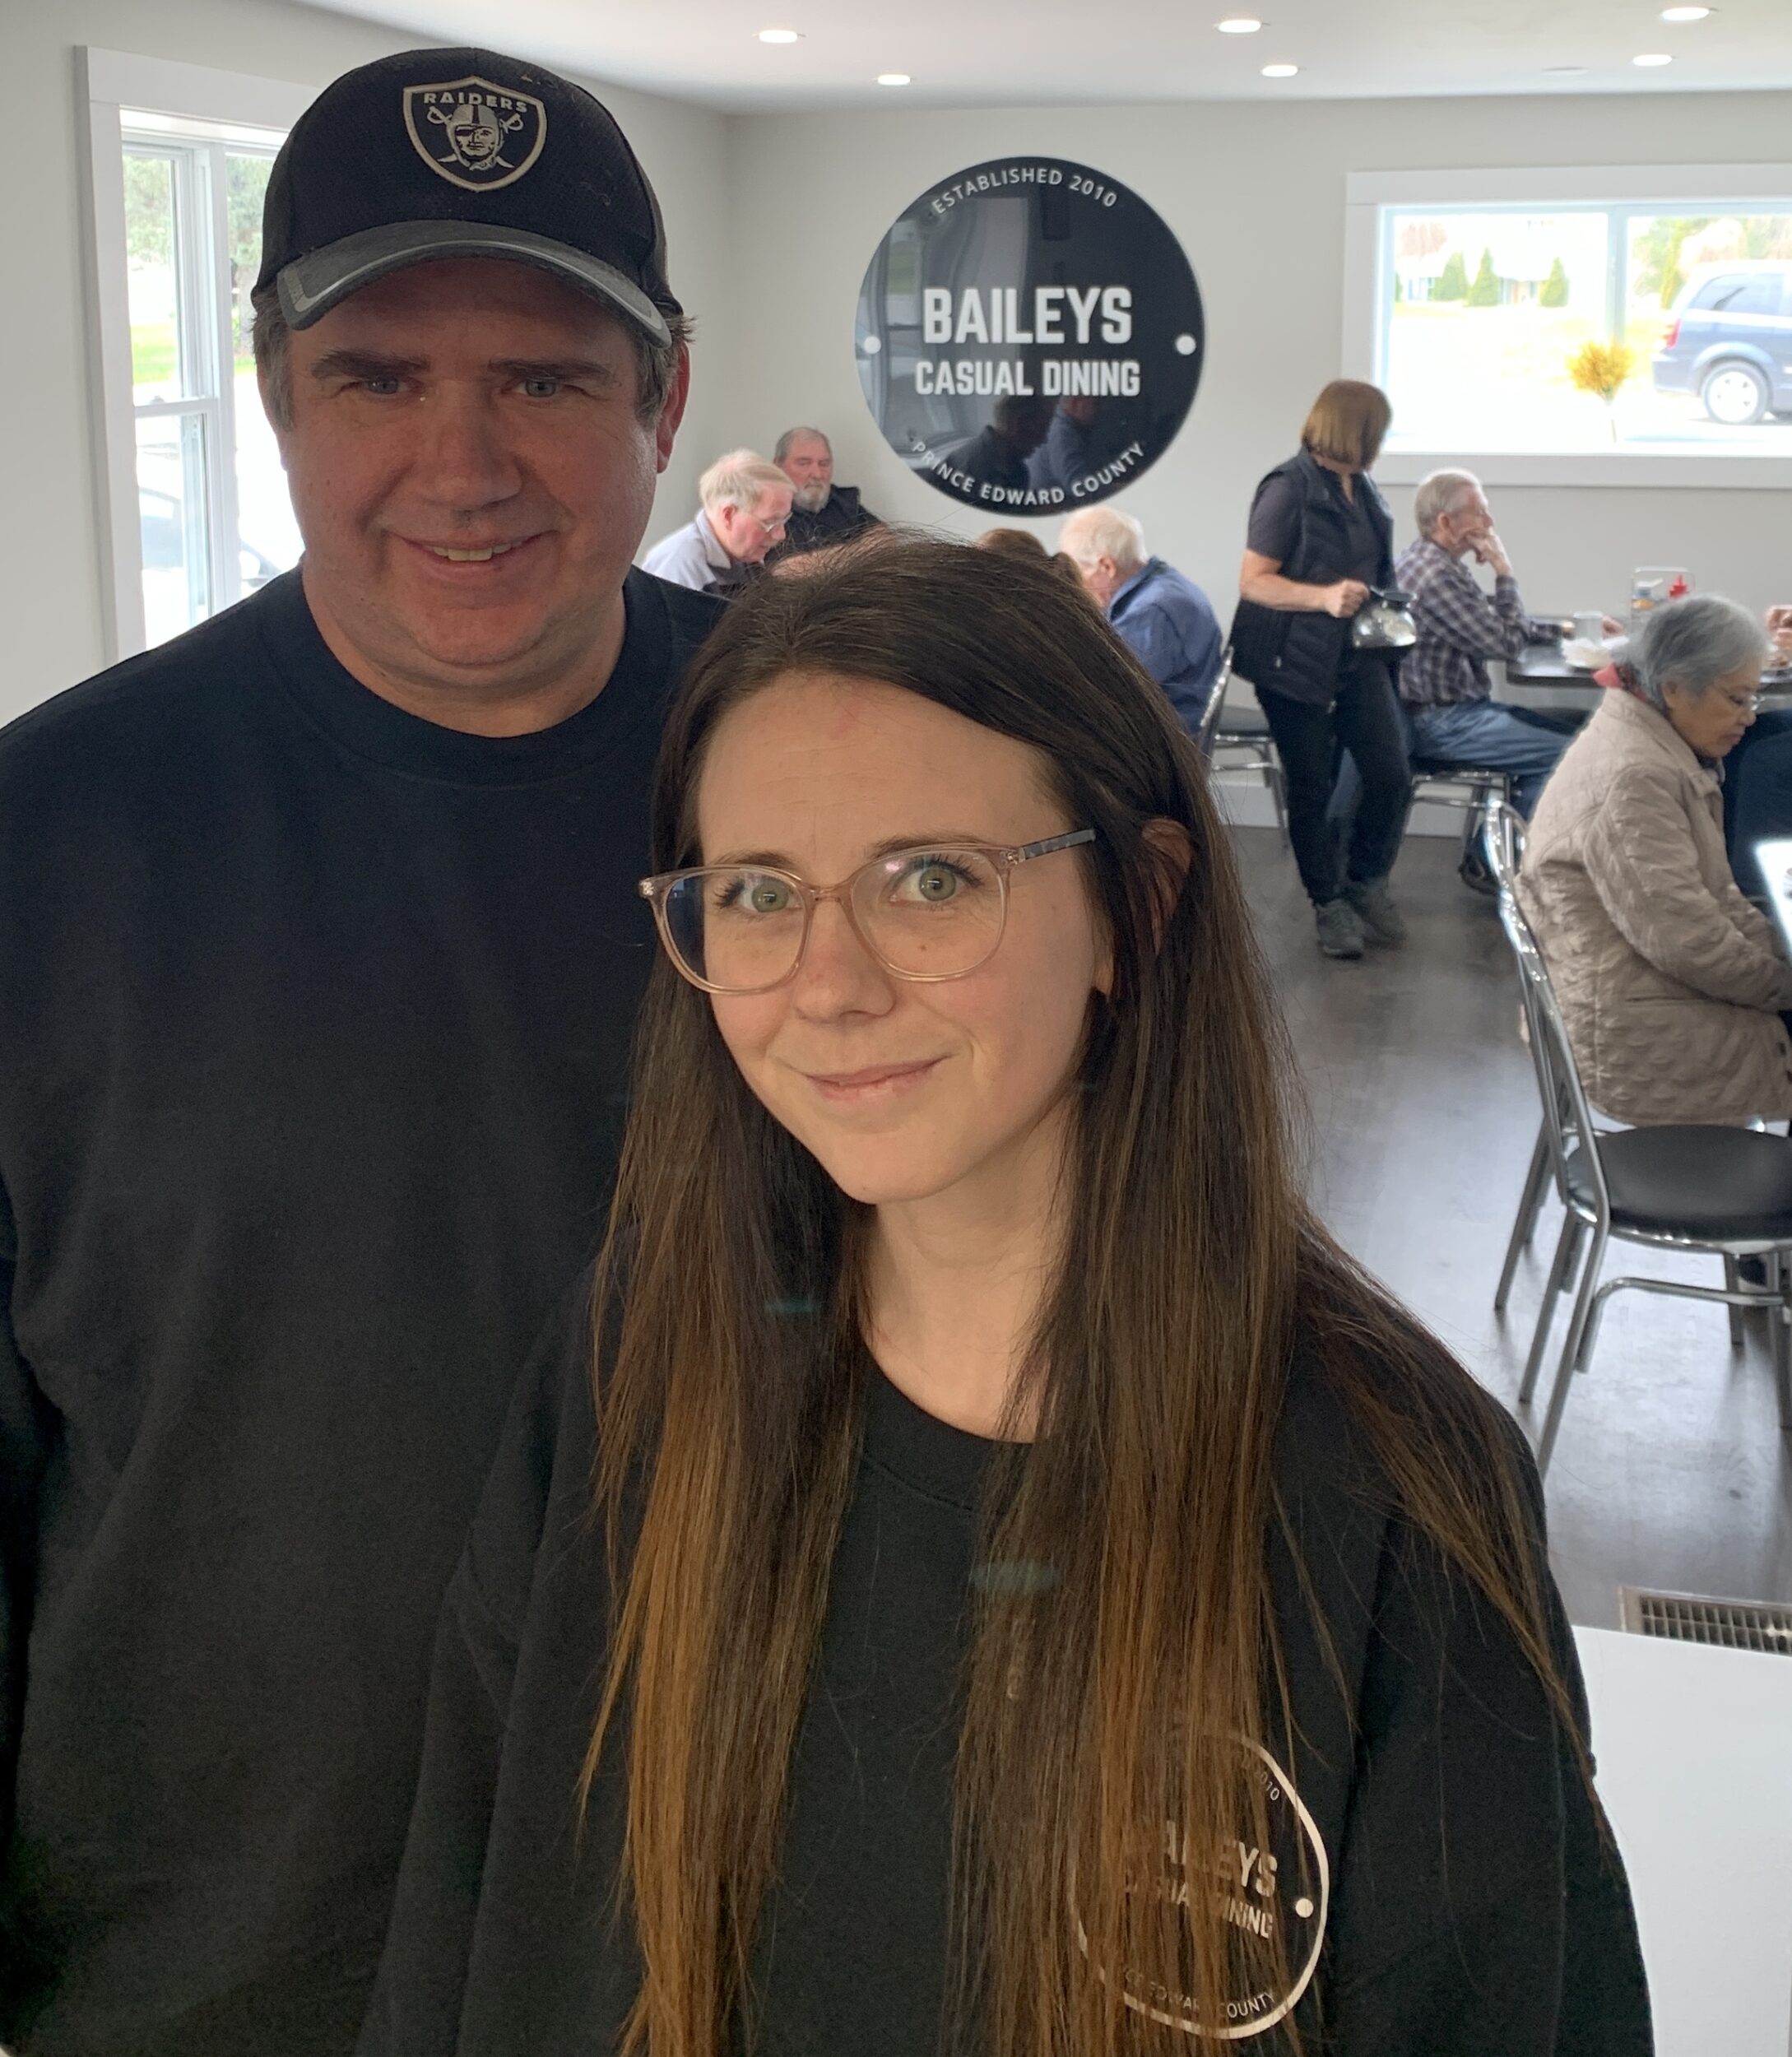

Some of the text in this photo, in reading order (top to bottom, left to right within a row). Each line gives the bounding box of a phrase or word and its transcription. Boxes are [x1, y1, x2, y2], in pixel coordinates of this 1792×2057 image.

[423, 91, 527, 113] RAIDERS
[931, 167, 1117, 214] ESTABLISHED 2010
[922, 286, 1133, 344] BAILEYS
[915, 360, 1141, 397] CASUAL DINING
[912, 441, 1145, 506] PRINCE EDWARD COUNTY
